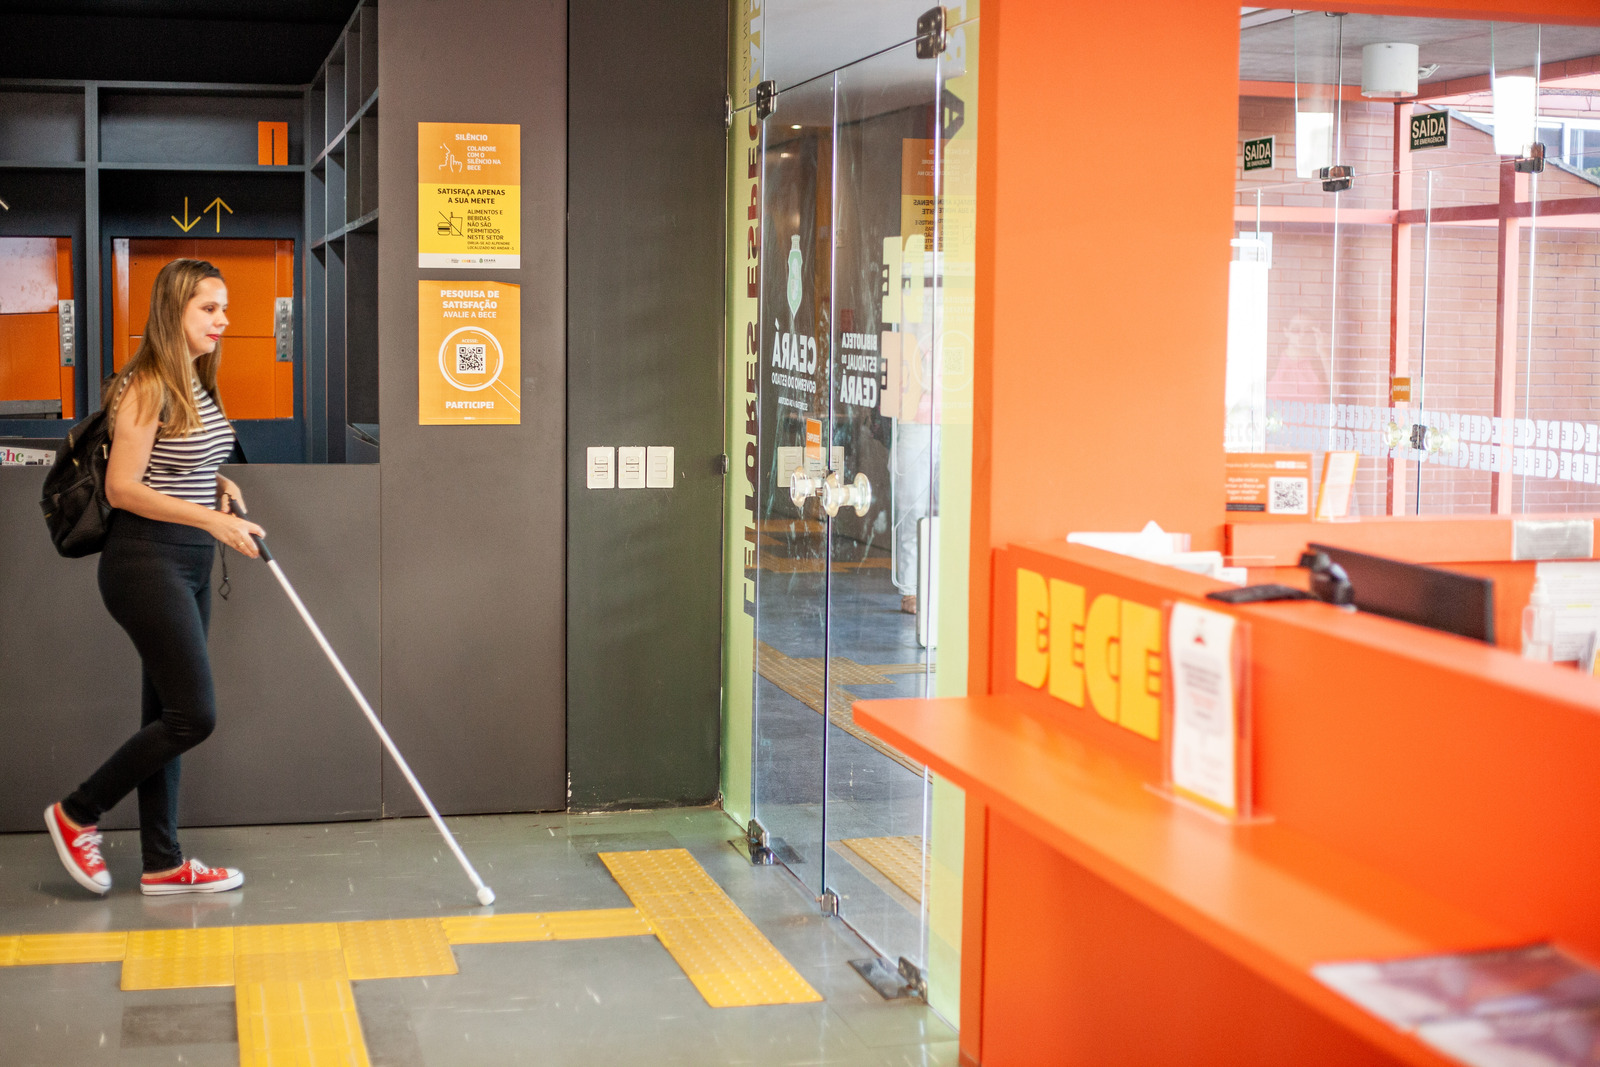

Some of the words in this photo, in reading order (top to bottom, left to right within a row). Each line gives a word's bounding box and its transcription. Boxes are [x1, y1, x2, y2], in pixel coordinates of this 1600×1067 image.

[1412, 114, 1446, 139] SAÍDA
[455, 133, 488, 142] SILÊNCIO
[1246, 140, 1271, 161] SAÍDA
[438, 188, 475, 196] SATISFAÇA
[440, 290, 485, 299] PESQUISA
[442, 300, 497, 311] SATISFAÇÃO
[1016, 567, 1162, 742] BECE
